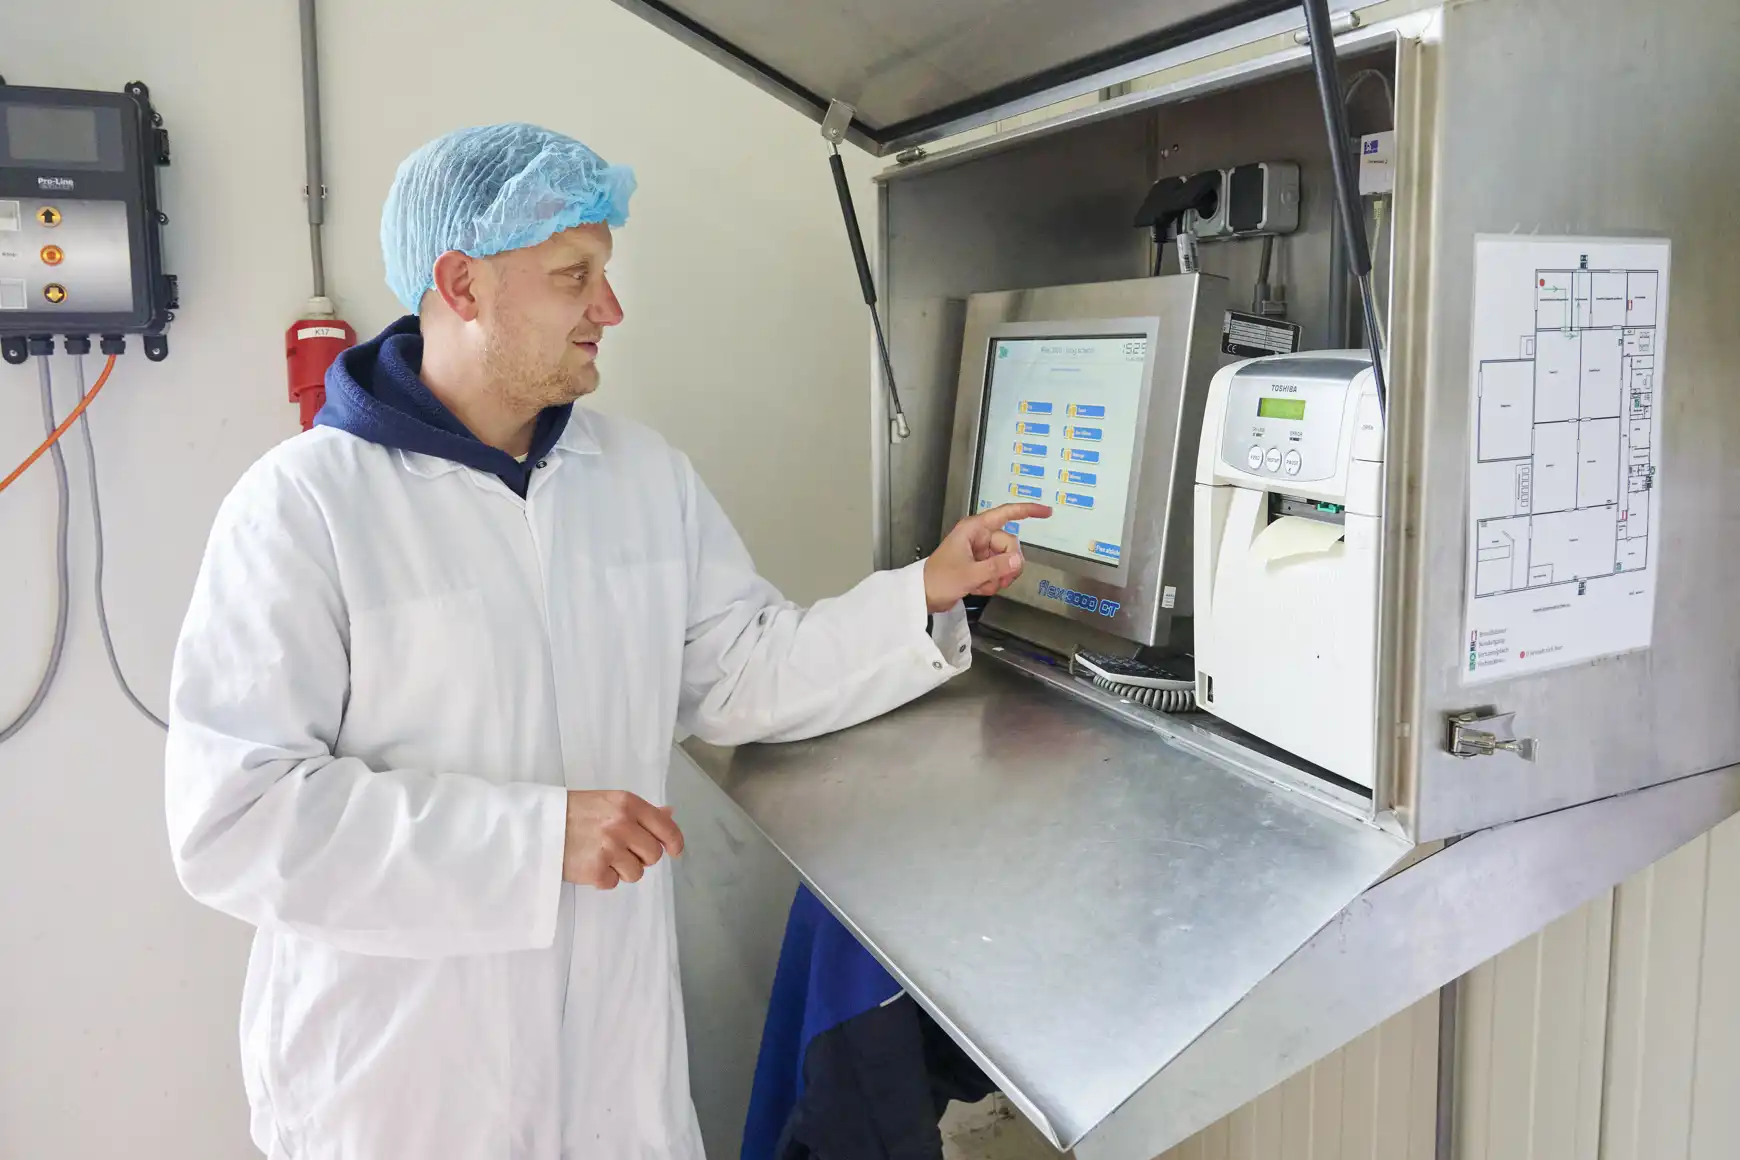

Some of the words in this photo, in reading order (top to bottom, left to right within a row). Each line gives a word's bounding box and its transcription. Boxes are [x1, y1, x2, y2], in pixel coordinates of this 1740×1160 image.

[37, 177, 74, 186] Pro-Line
[1271, 384, 1298, 393] TOSHIBA
[1099, 599, 1120, 617] CT
